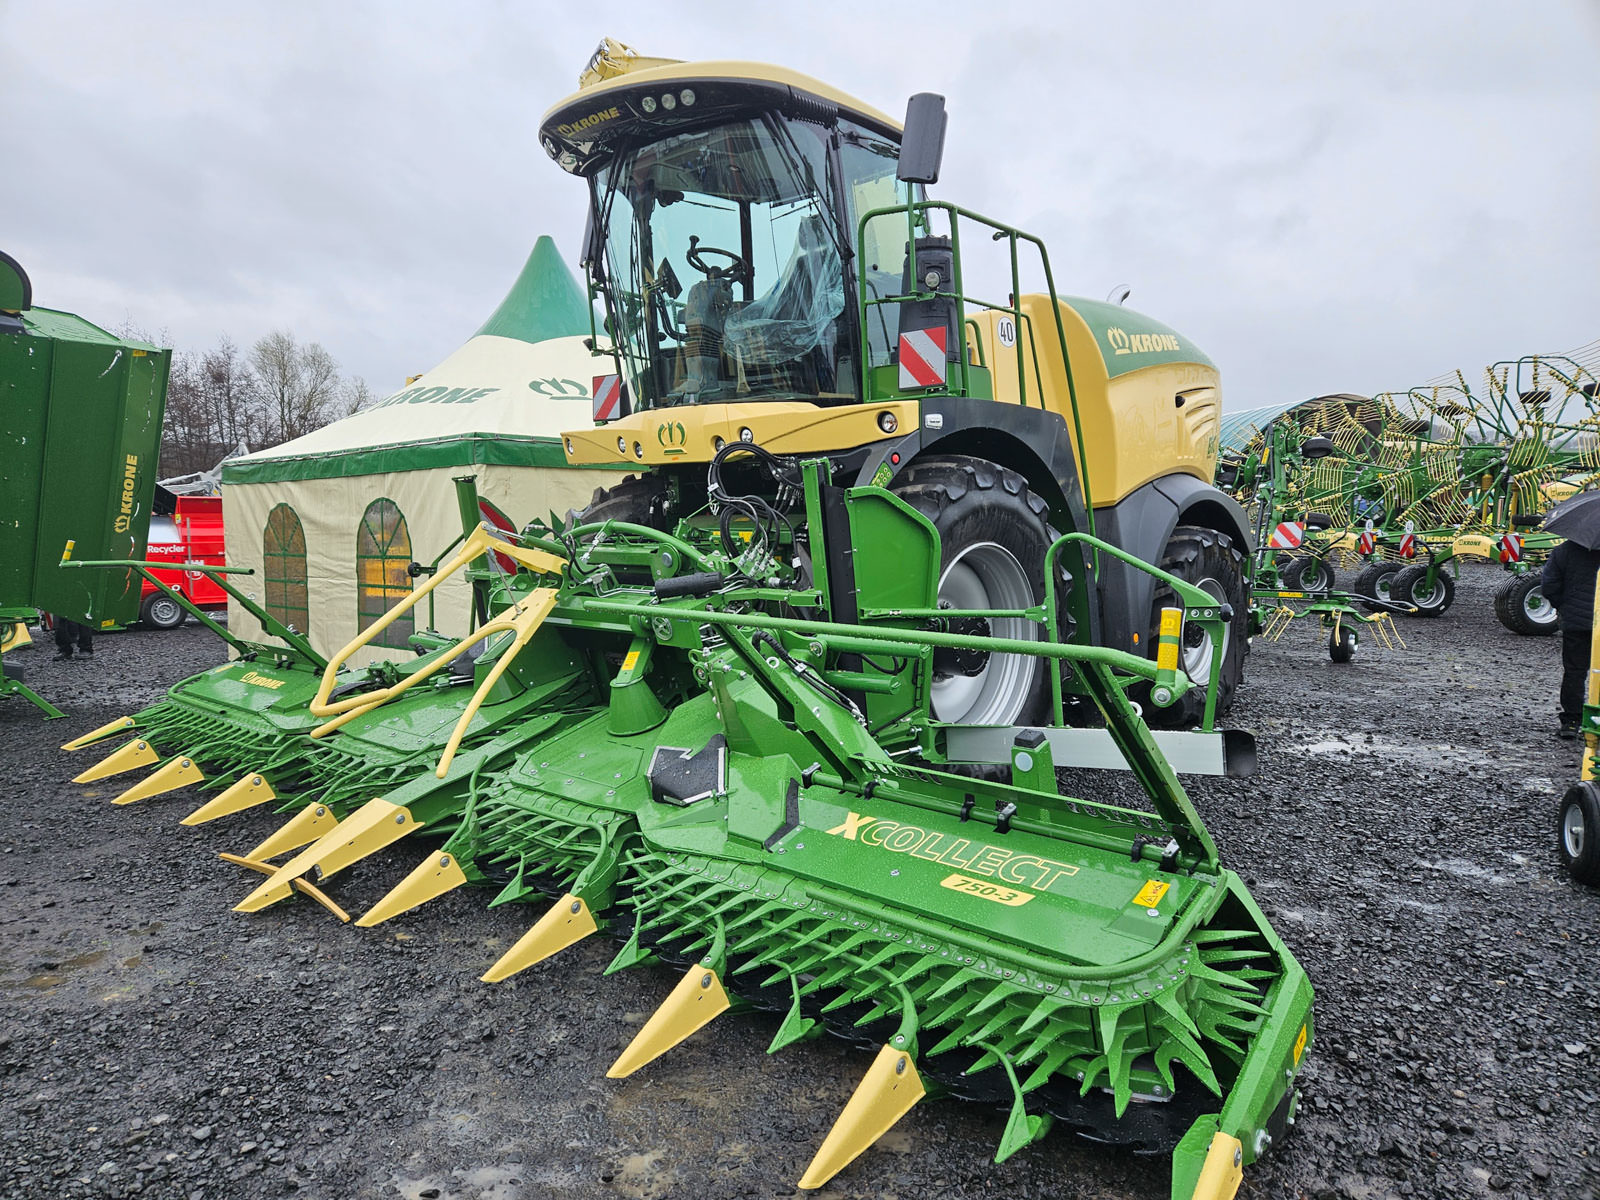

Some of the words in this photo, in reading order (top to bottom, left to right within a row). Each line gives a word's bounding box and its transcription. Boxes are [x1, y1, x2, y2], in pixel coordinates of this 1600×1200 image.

[571, 107, 620, 133] KRONE
[1000, 322, 1014, 342] 40
[1129, 333, 1180, 353] KRONE
[120, 454, 138, 514] KRONE
[147, 545, 185, 555] Recycler
[825, 811, 1080, 891] XCOLLECT
[953, 879, 1018, 902] 750-3
